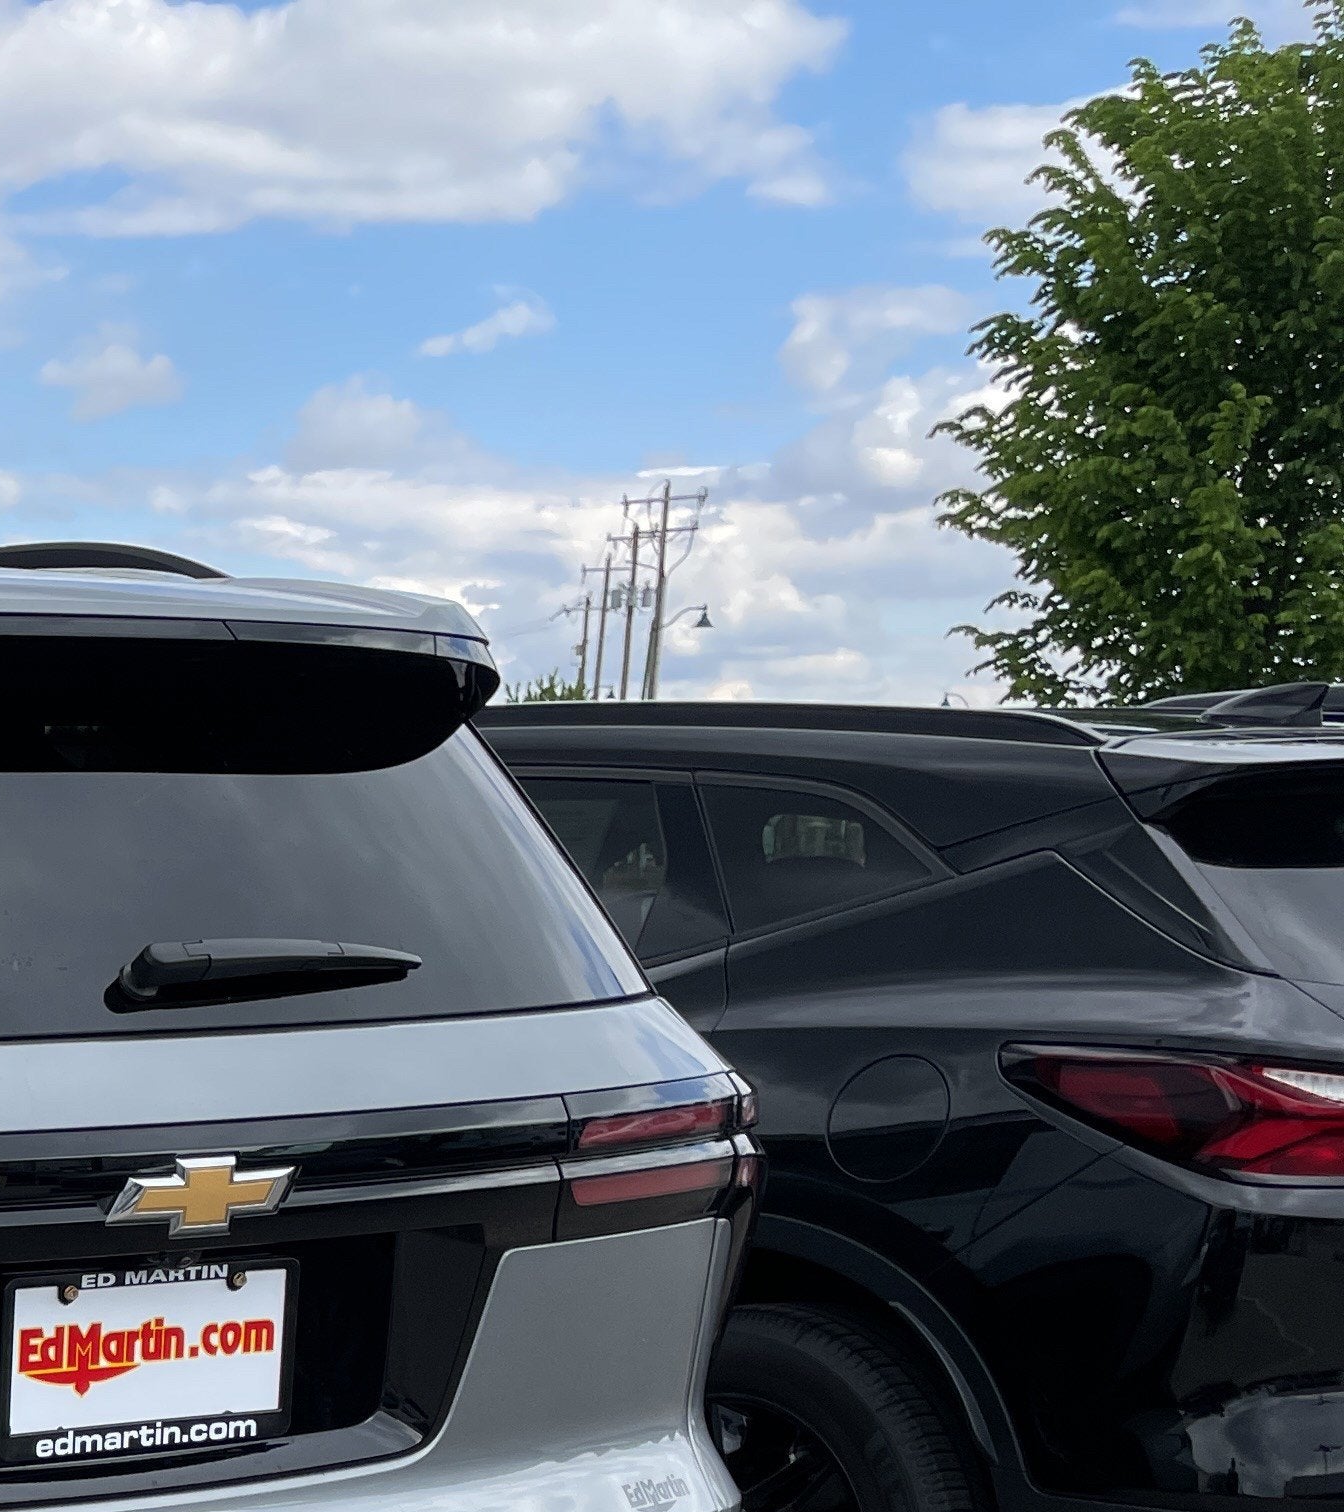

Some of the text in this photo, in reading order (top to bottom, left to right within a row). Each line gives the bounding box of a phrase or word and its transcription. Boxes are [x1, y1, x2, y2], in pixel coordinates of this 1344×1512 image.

[81, 1264, 228, 1289] ED MARTIN
[35, 1418, 257, 1458] edmartin.com
